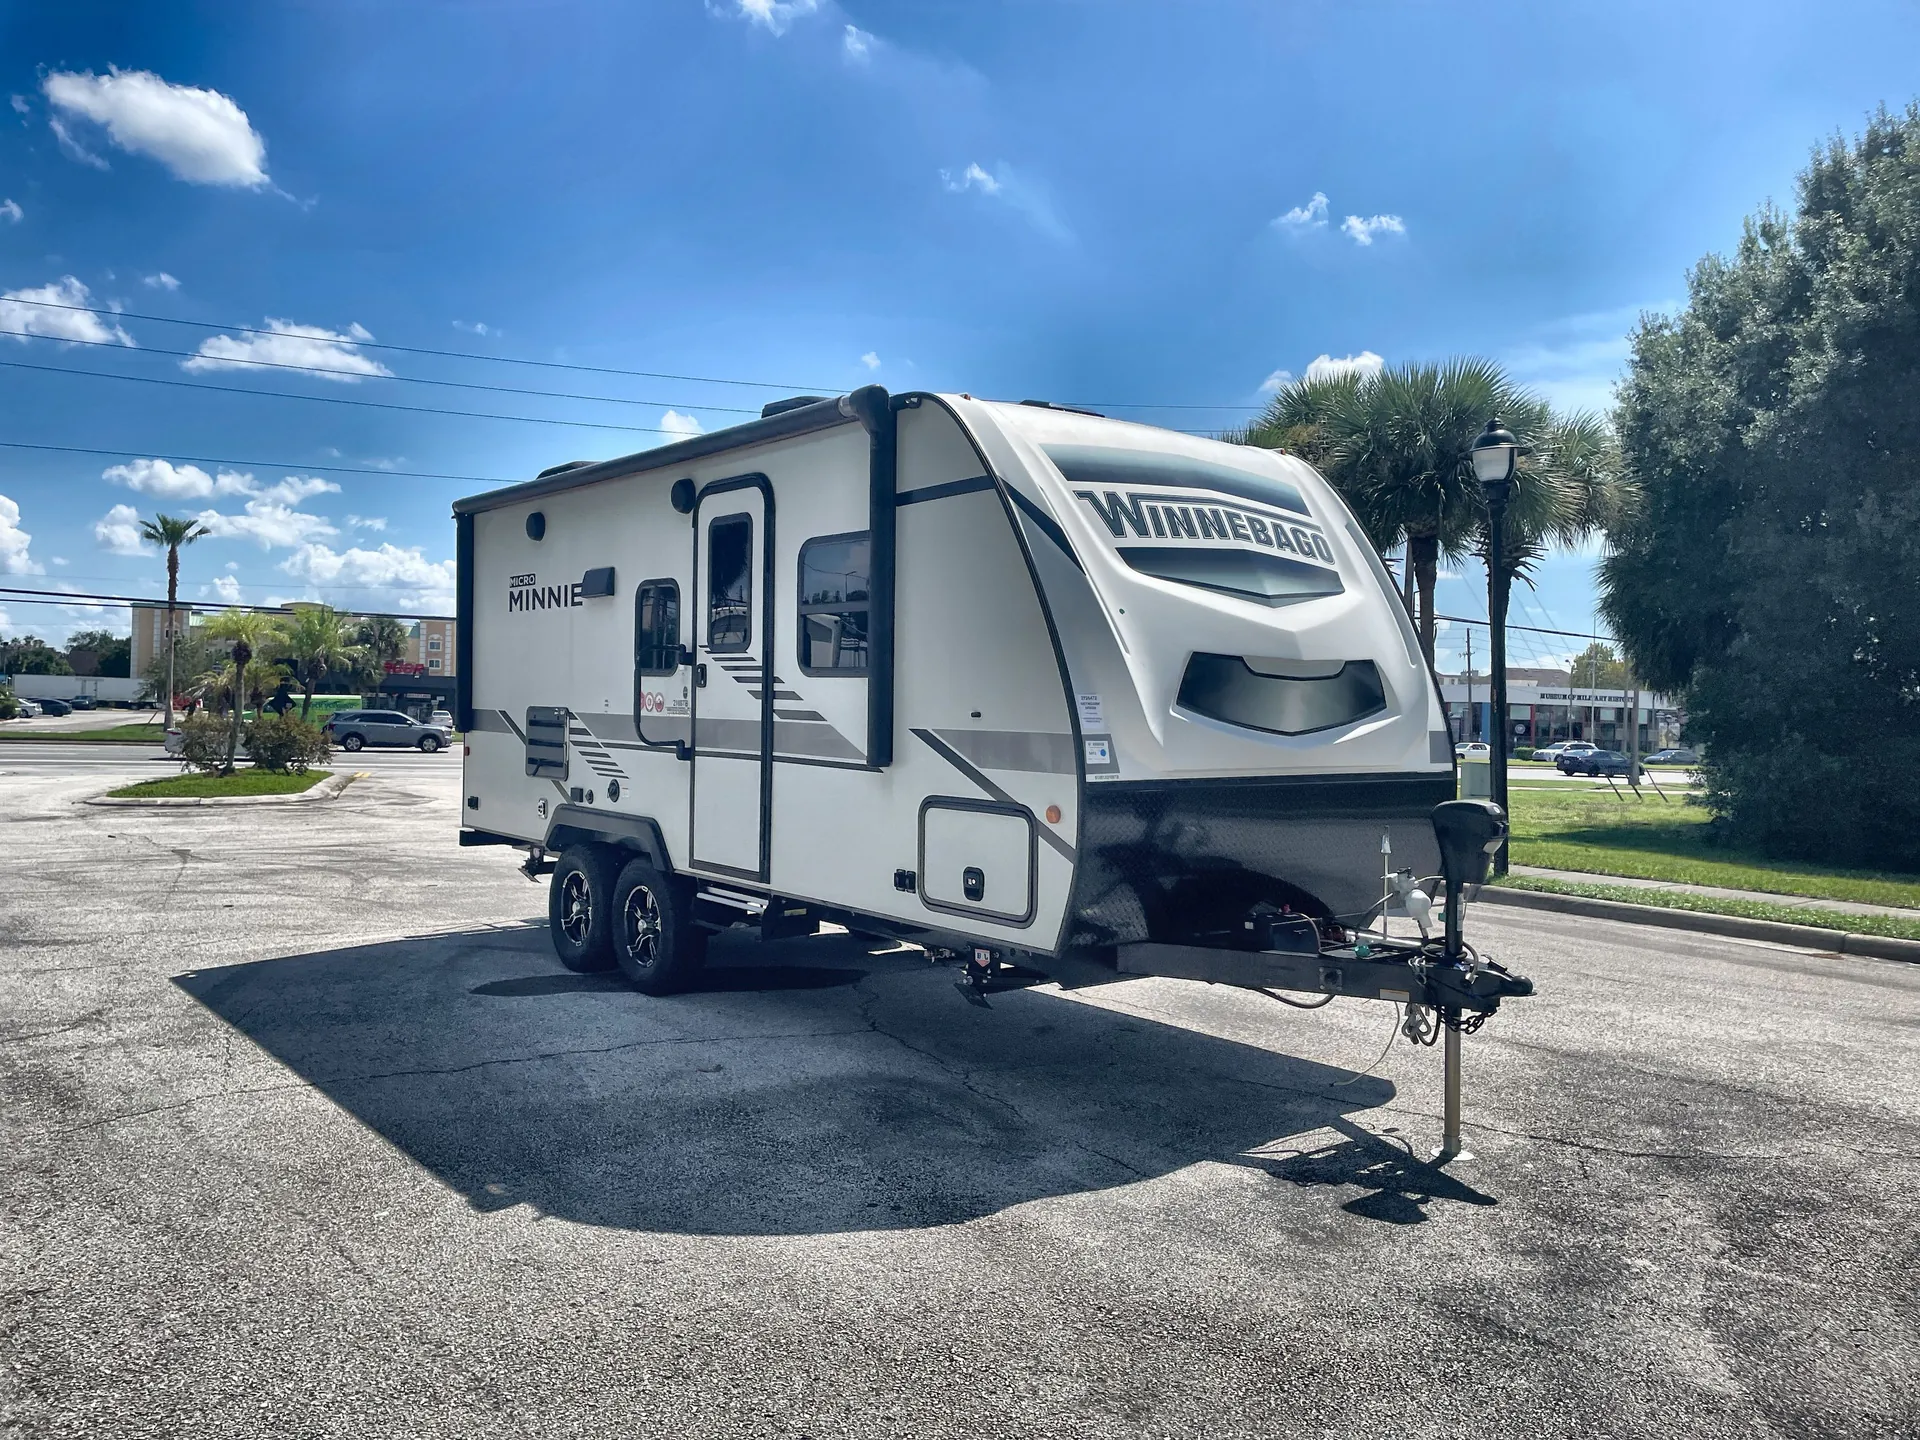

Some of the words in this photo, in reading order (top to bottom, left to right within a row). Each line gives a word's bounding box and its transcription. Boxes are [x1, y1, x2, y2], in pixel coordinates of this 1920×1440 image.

[1073, 489, 1336, 565] WINNEBAGO
[510, 575, 535, 587] MICRO
[509, 583, 583, 612] MINNIE
